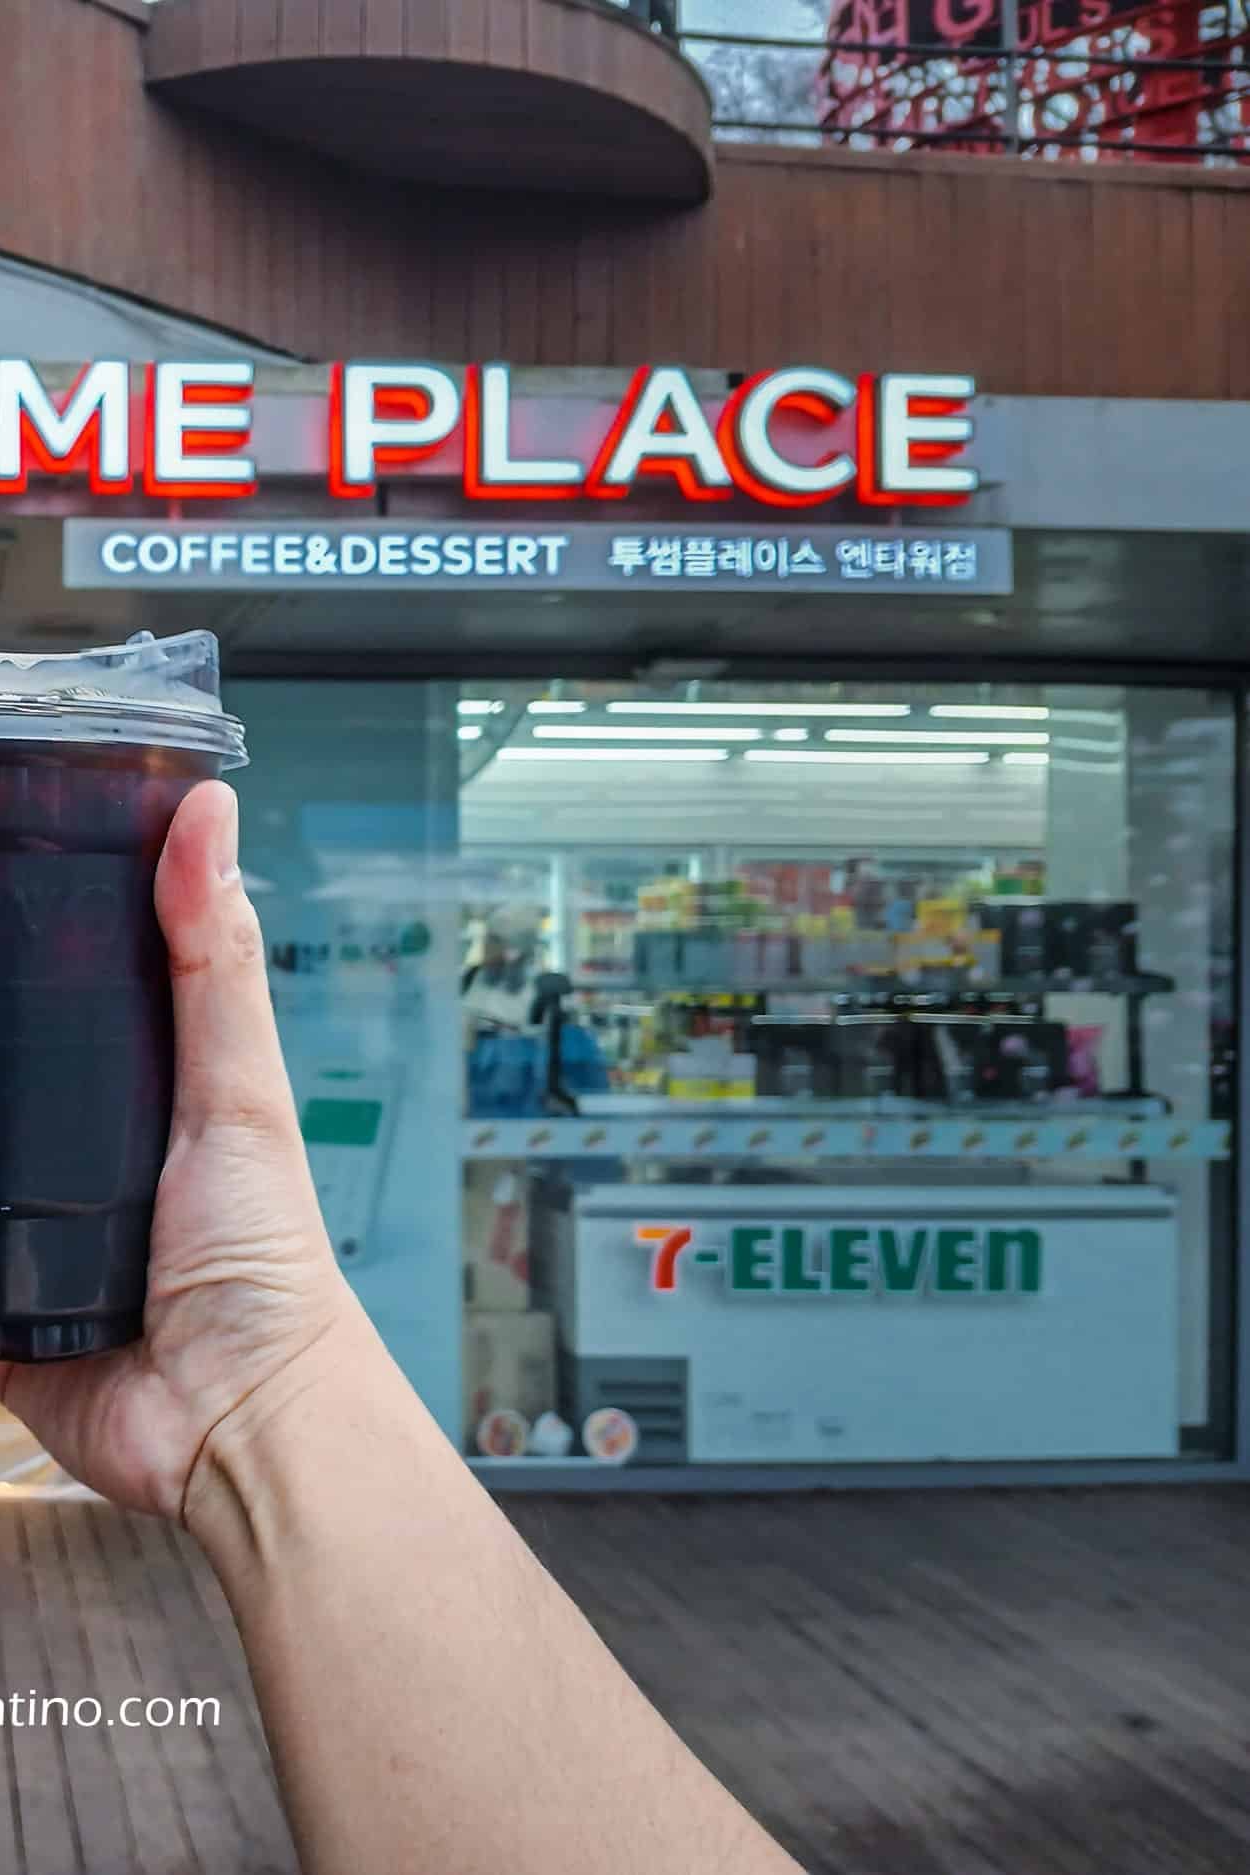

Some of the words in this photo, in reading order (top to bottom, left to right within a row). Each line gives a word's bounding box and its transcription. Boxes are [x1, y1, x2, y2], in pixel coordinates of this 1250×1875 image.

[329, 360, 979, 508] PLACE
[100, 533, 570, 577] COFFEE&DESSERT
[609, 536, 826, 578] 투썸플레이스
[836, 538, 978, 582] 엔타워점
